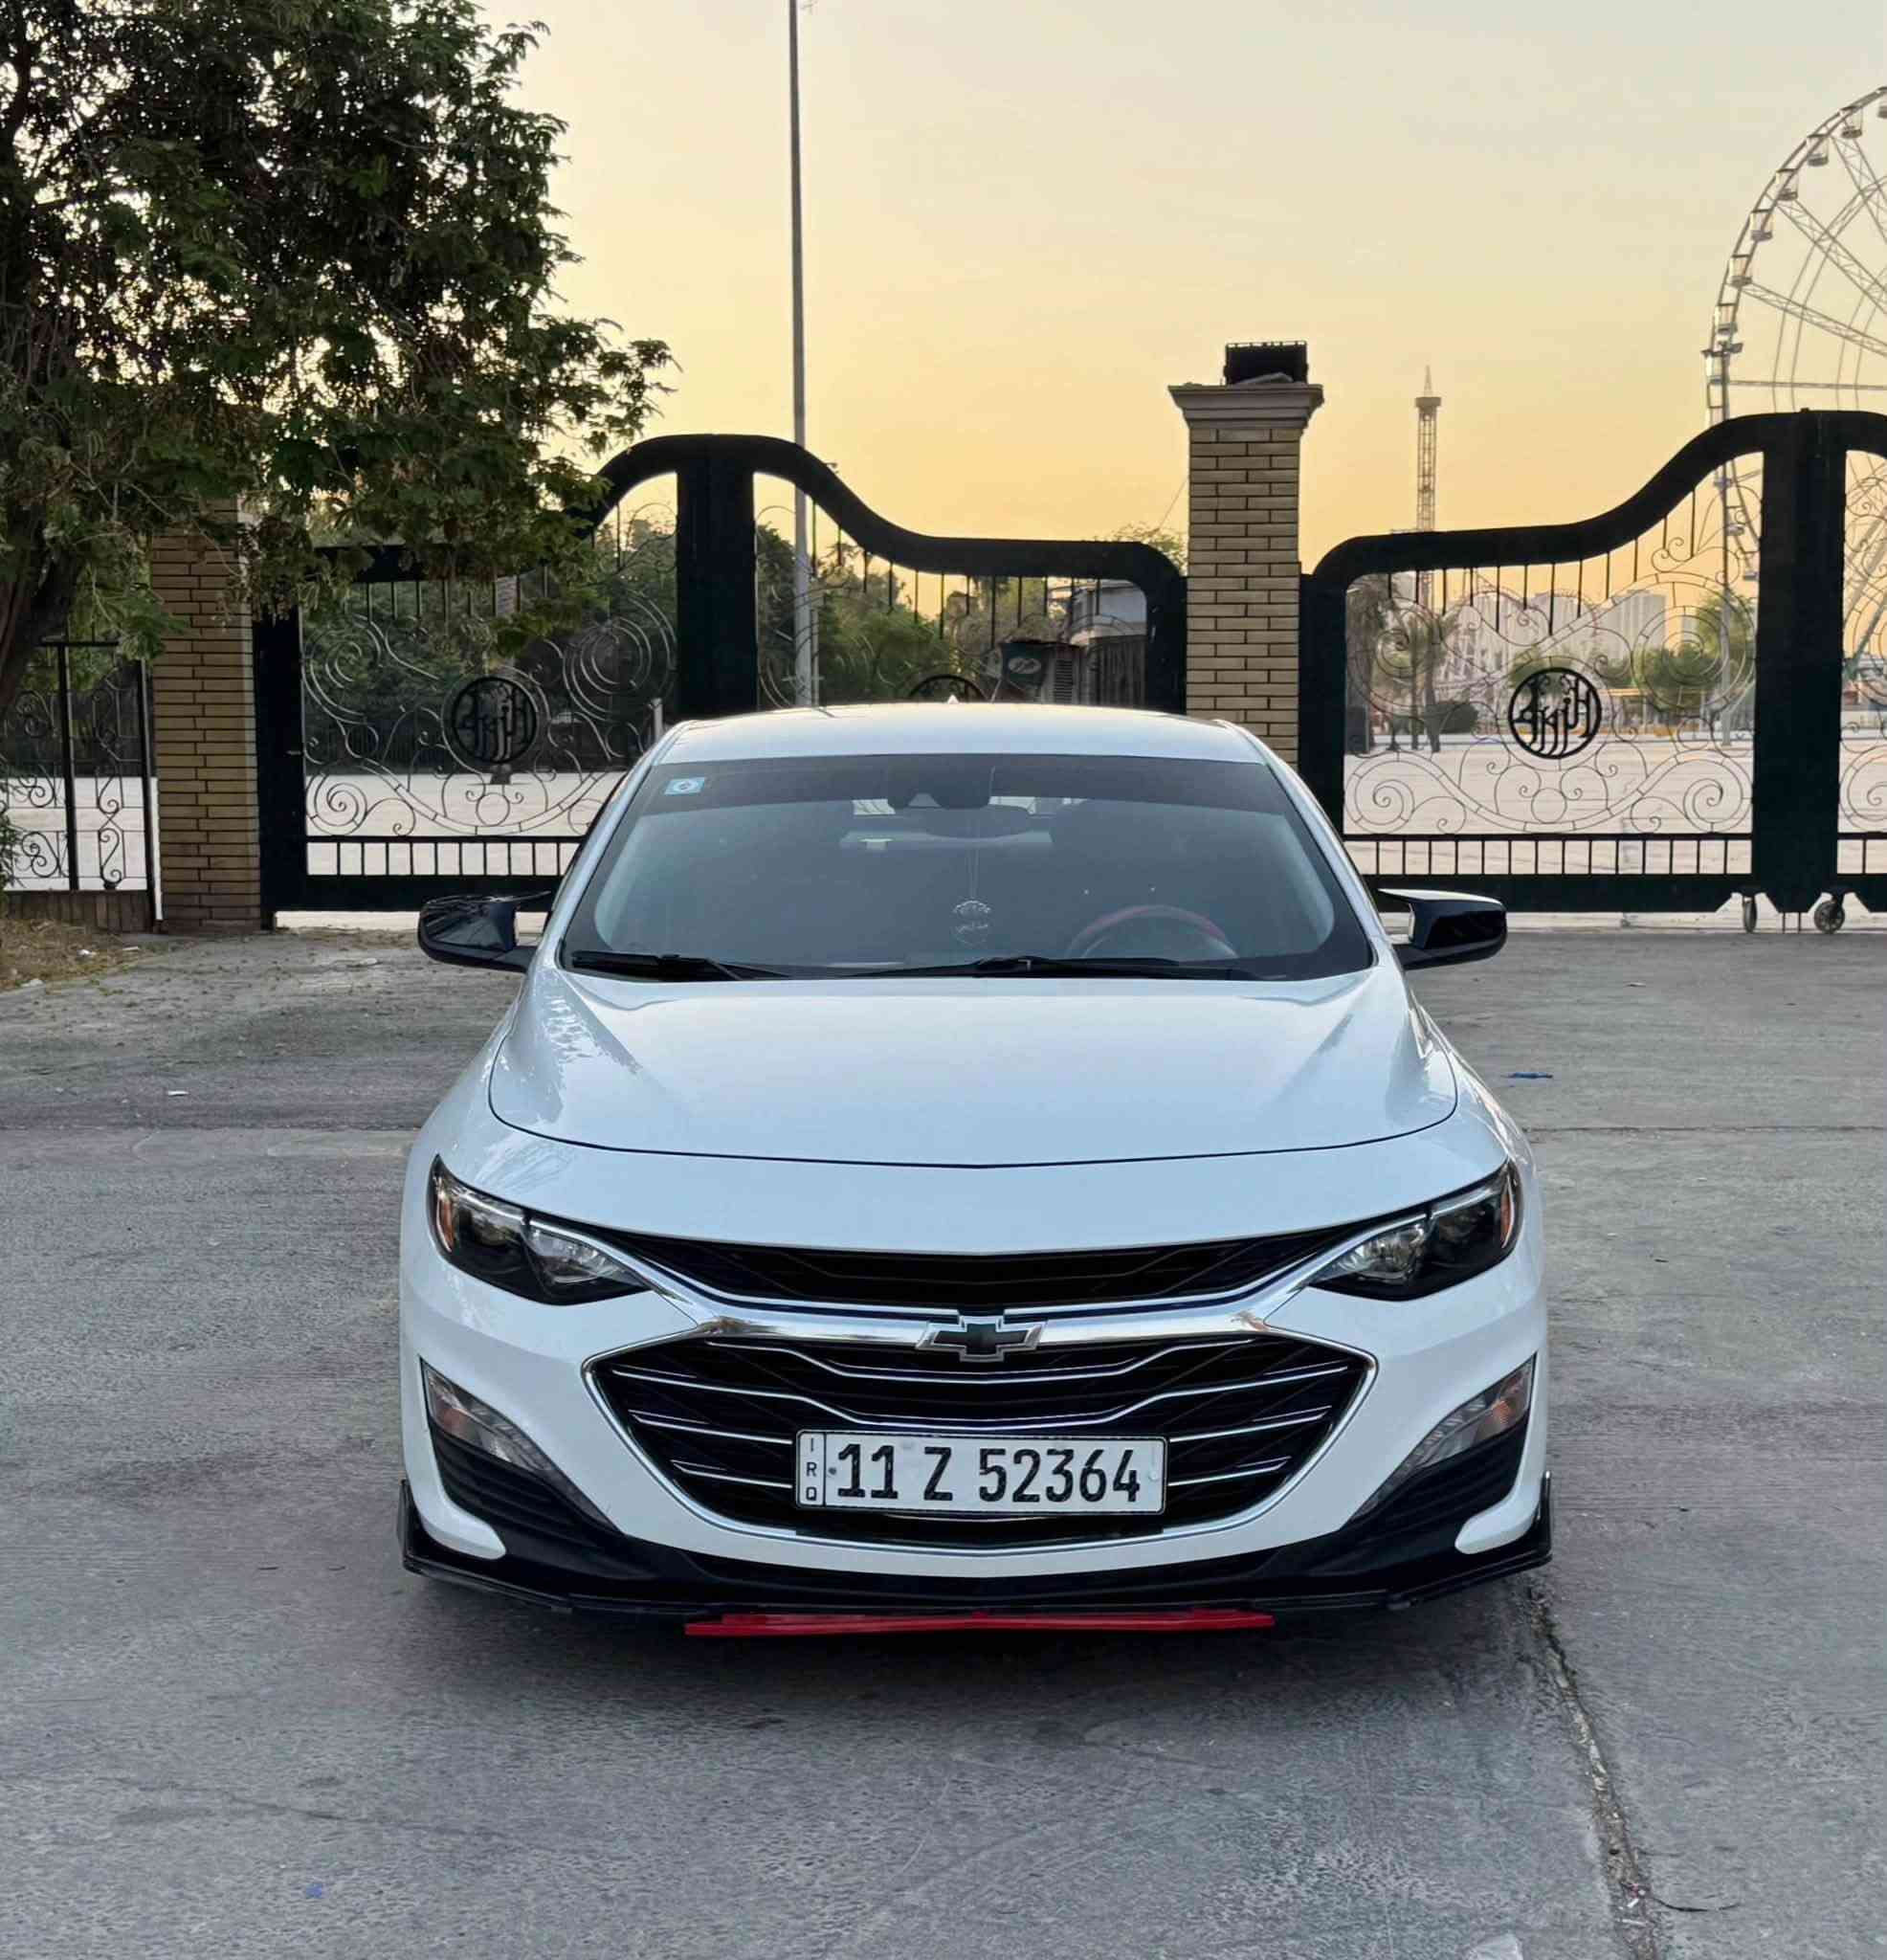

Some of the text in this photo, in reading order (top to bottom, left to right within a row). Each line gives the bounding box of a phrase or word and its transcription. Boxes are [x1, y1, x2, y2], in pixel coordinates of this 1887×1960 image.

[806, 1437, 817, 1502] IRQ
[836, 1443, 1141, 1503] 11 Z 52364
